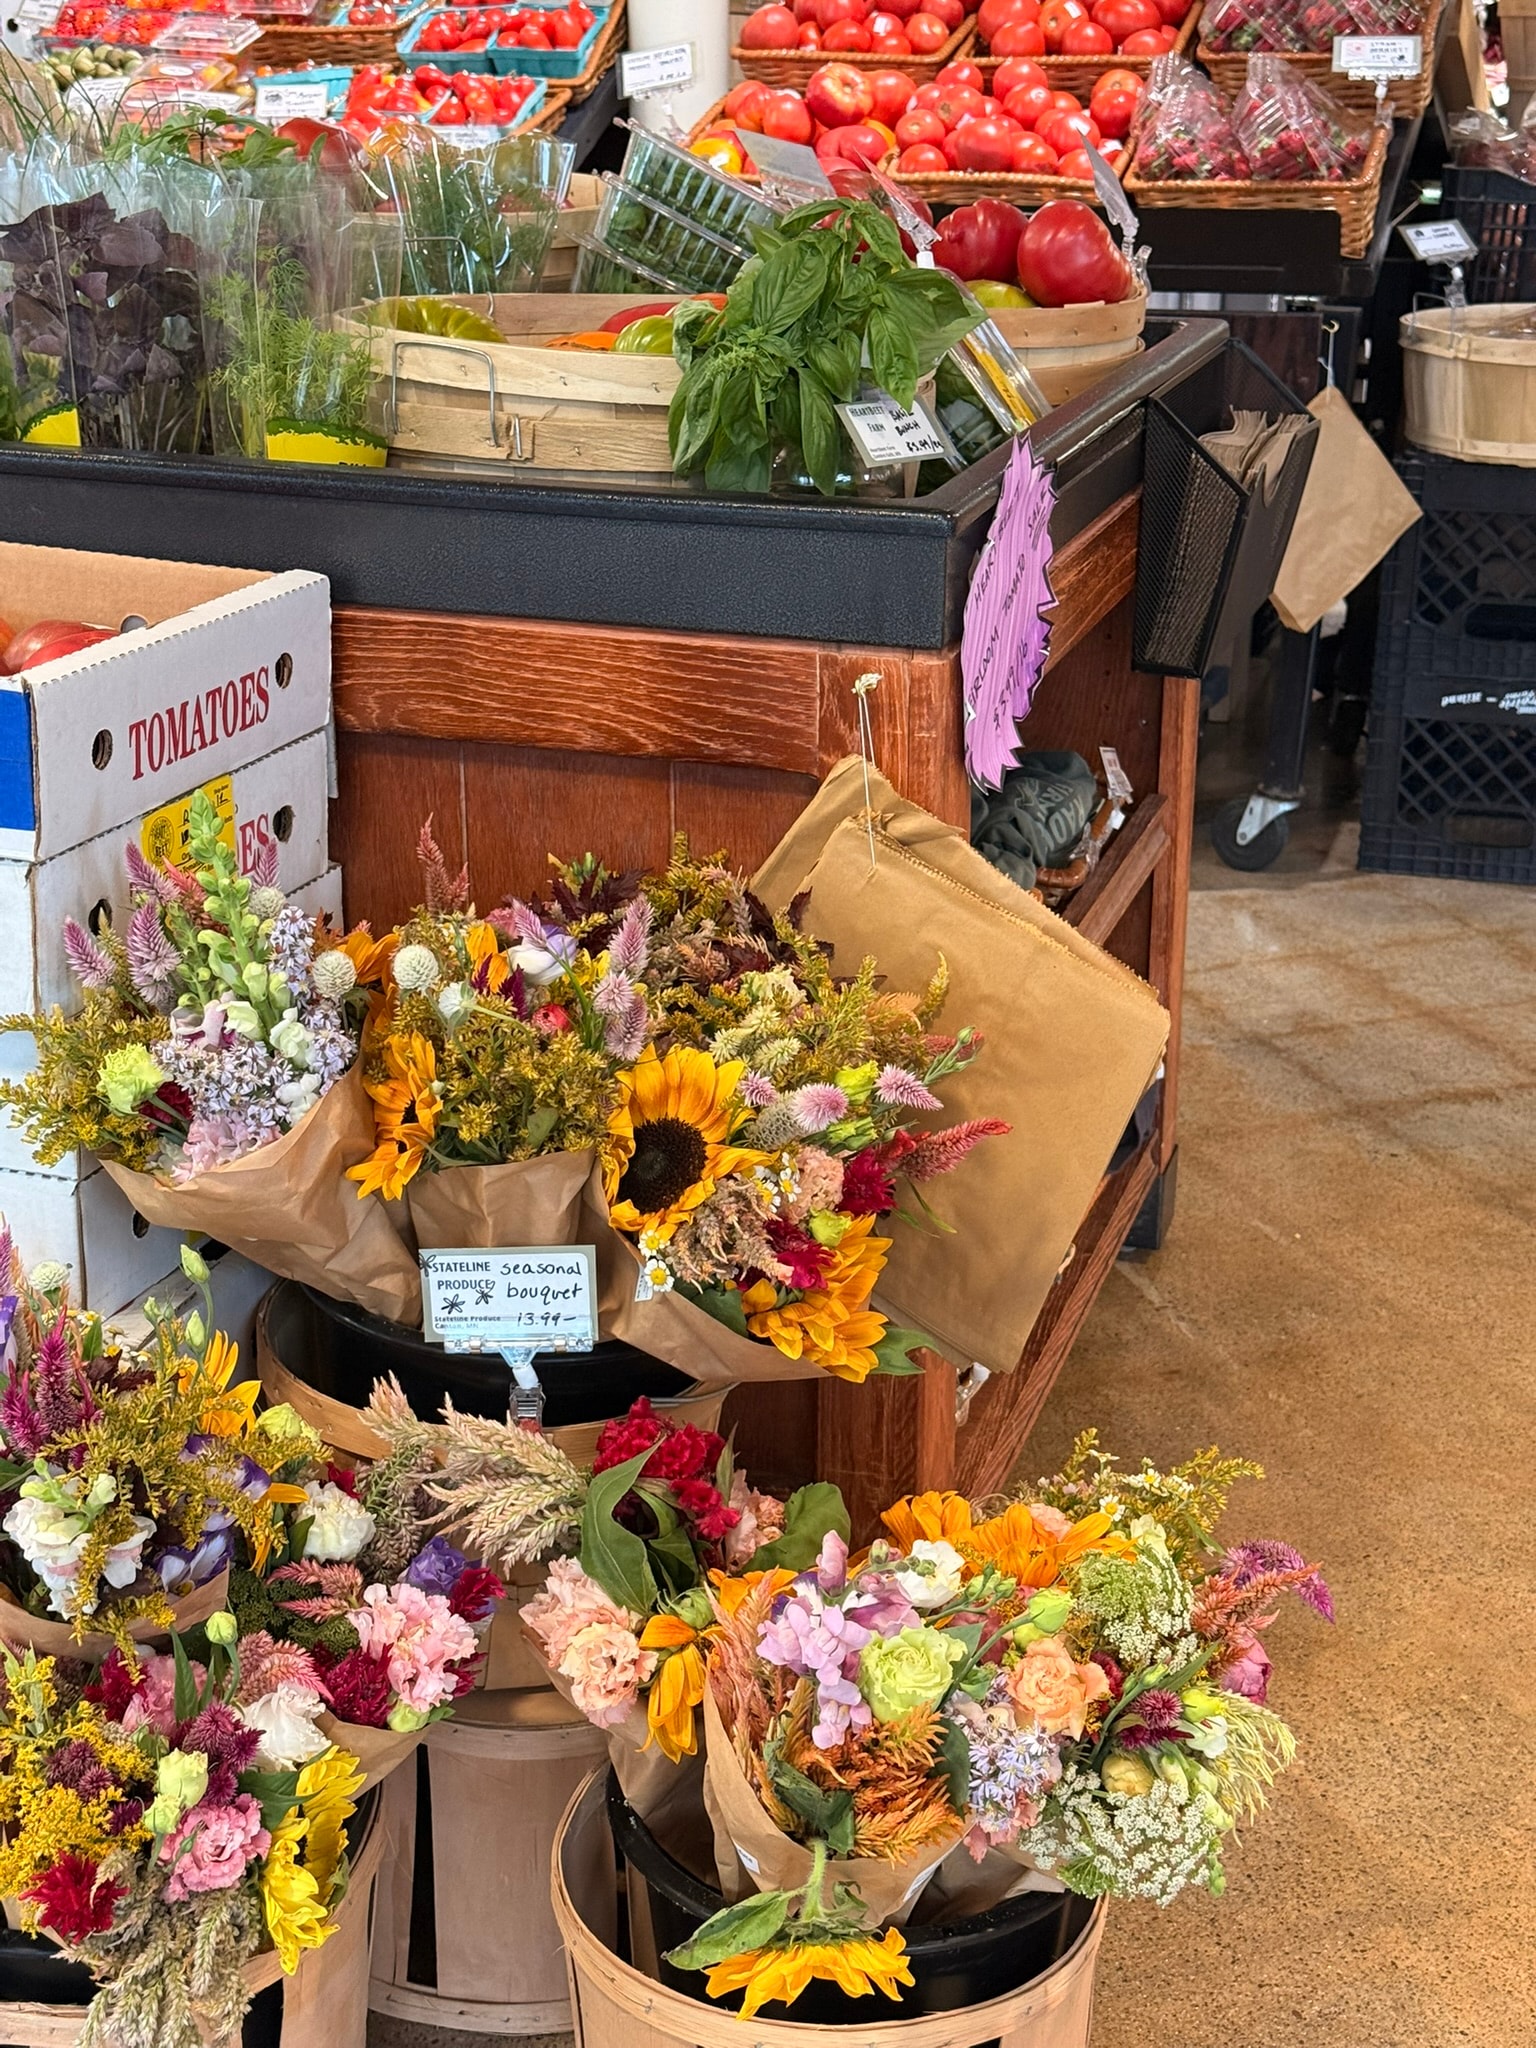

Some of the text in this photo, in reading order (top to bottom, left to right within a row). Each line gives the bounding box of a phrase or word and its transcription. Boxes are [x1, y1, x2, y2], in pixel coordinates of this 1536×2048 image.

[968, 625, 999, 706] EIRLOOM
[128, 665, 270, 780] TOMATOES
[432, 1261, 491, 1273] STATELINE
[500, 1261, 583, 1276] seasonal
[437, 1279, 492, 1290] PRODUCE
[507, 1282, 583, 1306] bouquet
